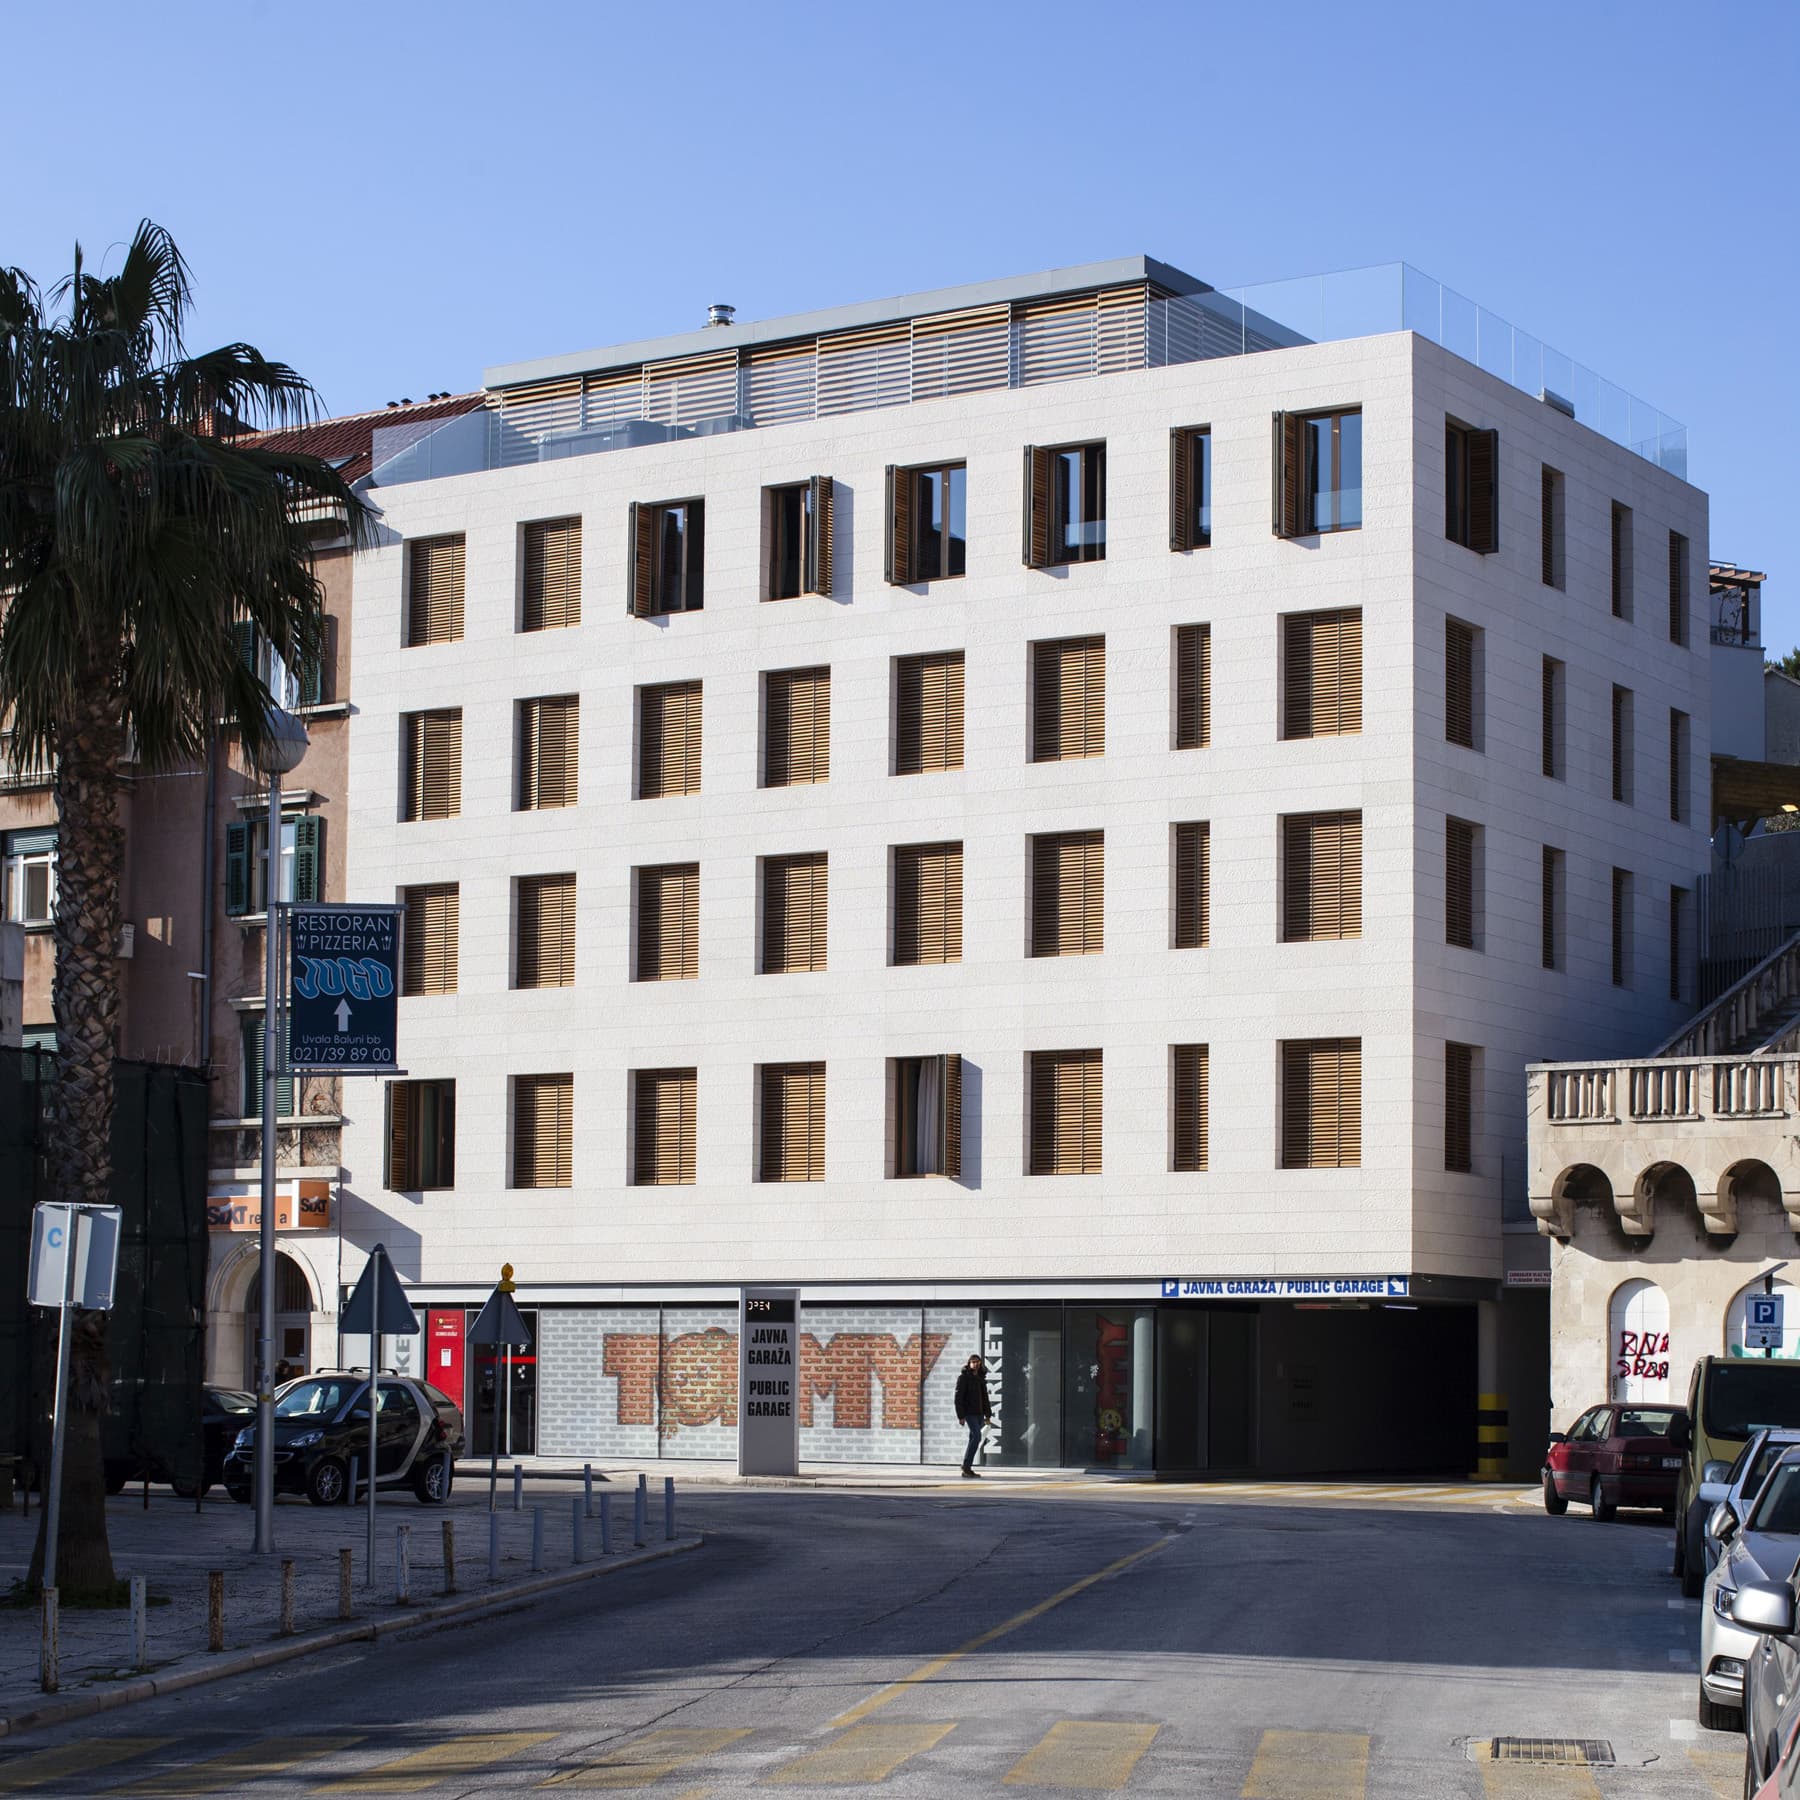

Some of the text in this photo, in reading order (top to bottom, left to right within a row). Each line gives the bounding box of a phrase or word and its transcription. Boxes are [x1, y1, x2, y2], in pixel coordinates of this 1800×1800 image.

[298, 915, 390, 932] RESTORAN
[310, 935, 380, 951] PIZZERIA
[294, 955, 394, 1000] JUGO
[302, 1034, 382, 1045] Uvala Baluni bb
[294, 1047, 391, 1062] 021/39 89 00
[47, 1227, 63, 1249] C
[1183, 1281, 1222, 1295] JAVNA
[1227, 1279, 1276, 1295] GARAŽA
[1287, 1281, 1330, 1294] PUBLIC
[1334, 1280, 1384, 1294] GARAGE
[751, 1329, 788, 1344] JAVNA
[748, 1347, 792, 1365] GARAŽA
[603, 1327, 951, 1429] TOMY
[749, 1381, 790, 1396] PUBLIC
[984, 1321, 1003, 1454] MARKET
[747, 1402, 791, 1417] GARAGE
